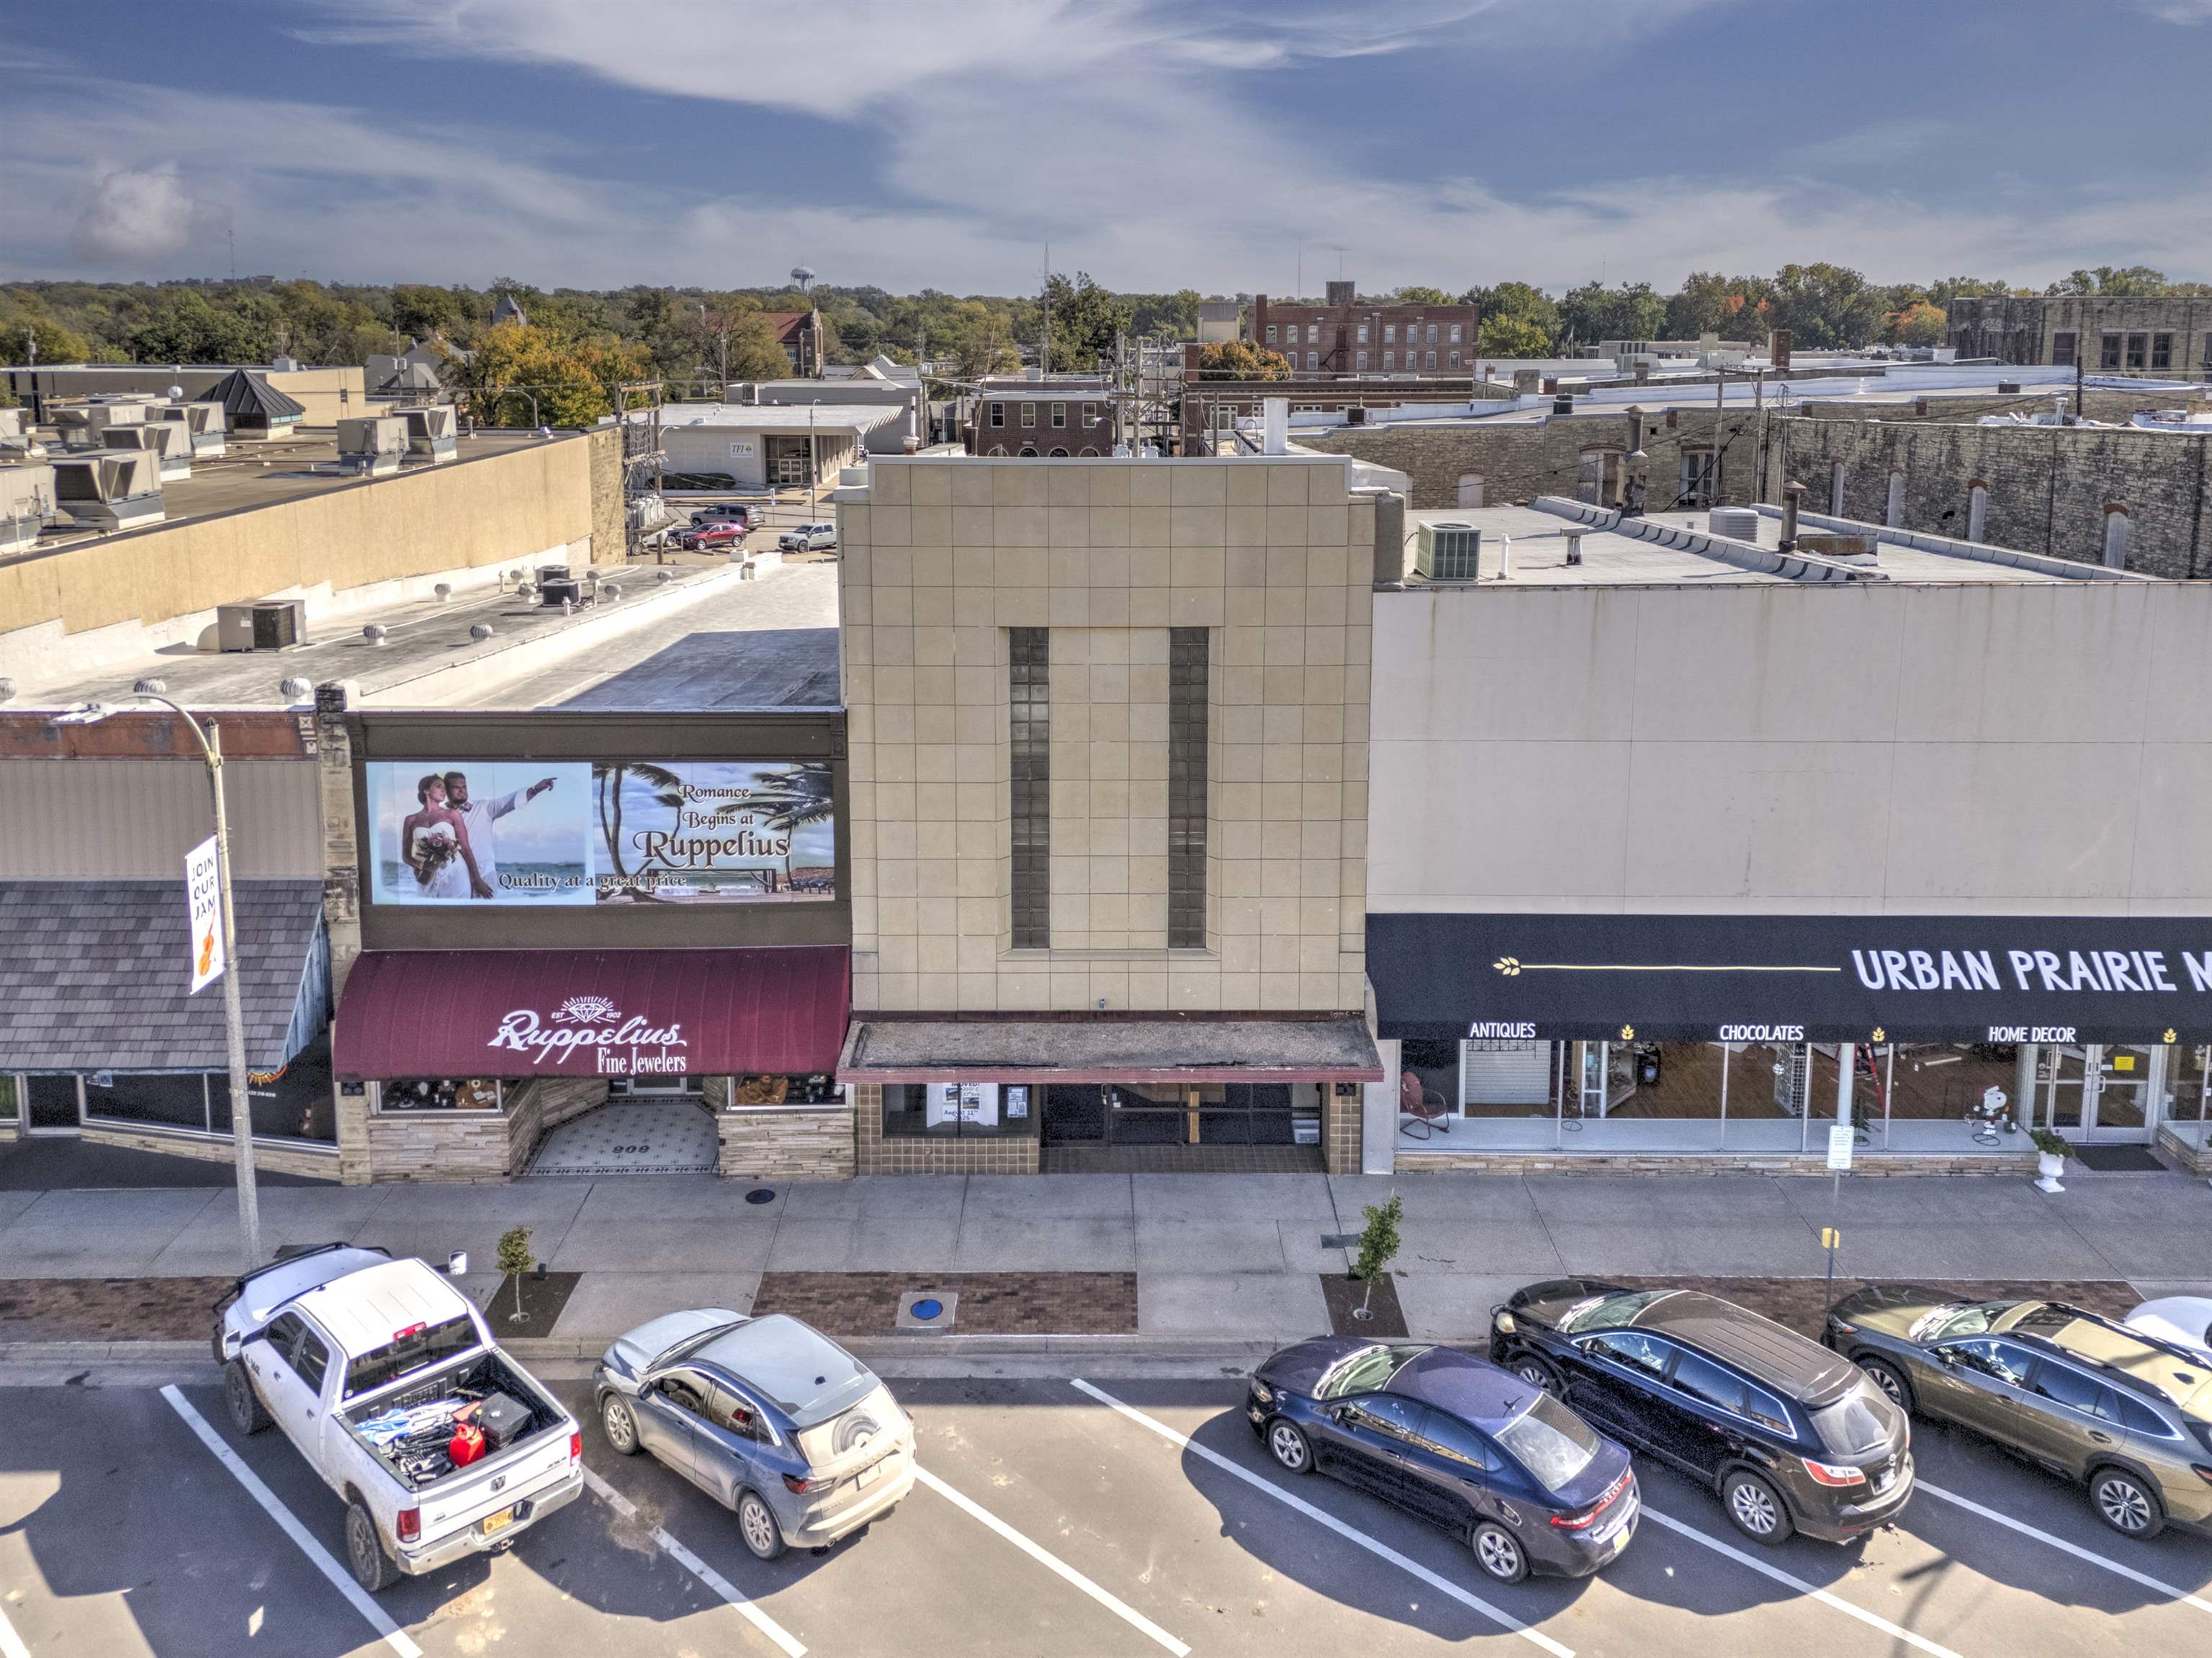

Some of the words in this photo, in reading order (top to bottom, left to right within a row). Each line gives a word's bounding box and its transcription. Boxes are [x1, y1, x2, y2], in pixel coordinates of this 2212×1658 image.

[732, 444, 745, 453] TFI
[678, 784, 750, 803] Romance
[683, 812, 735, 830] Begins
[740, 814, 755, 825] at
[634, 830, 789, 869] Ruppelius
[192, 855, 213, 881] JOIN
[194, 876, 215, 900] OUR
[498, 874, 560, 892] Quality
[565, 875, 580, 887] at
[585, 877, 595, 887] a
[599, 875, 641, 891] great
[645, 874, 687, 891] price
[195, 895, 215, 920] JAM
[1852, 949, 2000, 991] URBAN
[2009, 950, 2177, 992] PRAIRIE
[487, 1010, 688, 1065] Ruppelius
[1470, 1022, 1536, 1038] ANTIQUES
[1719, 1024, 1804, 1041] CHOCOLATES
[1988, 1026, 2028, 1042] HOME
[2031, 1026, 2077, 1042] DECOR
[597, 1047, 627, 1073] Fine
[630, 1047, 686, 1075] Jewelers
